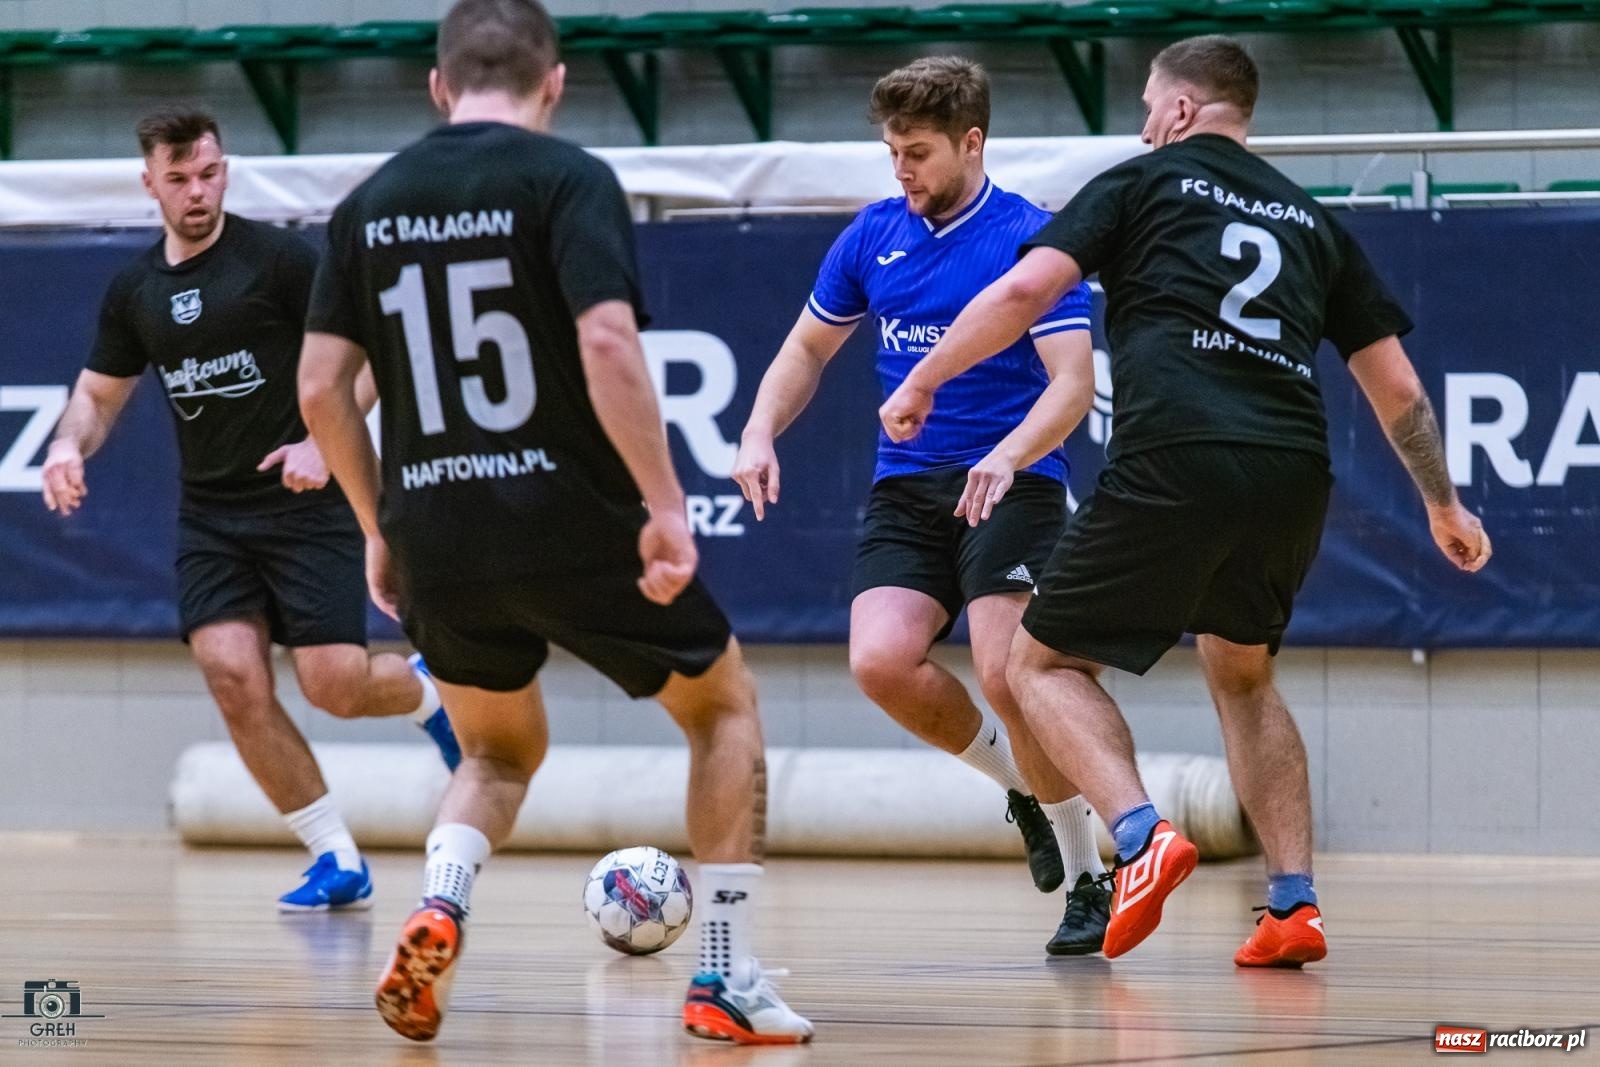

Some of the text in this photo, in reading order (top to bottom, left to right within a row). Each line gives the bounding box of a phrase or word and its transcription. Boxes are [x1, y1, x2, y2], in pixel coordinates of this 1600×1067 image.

[364, 209, 514, 248] FC BAŁAGAN
[1181, 178, 1315, 229] FC BAŁAGAN
[1219, 221, 1282, 341] 2
[378, 257, 537, 436] 15
[401, 448, 557, 490] HAFTOWN.PL
